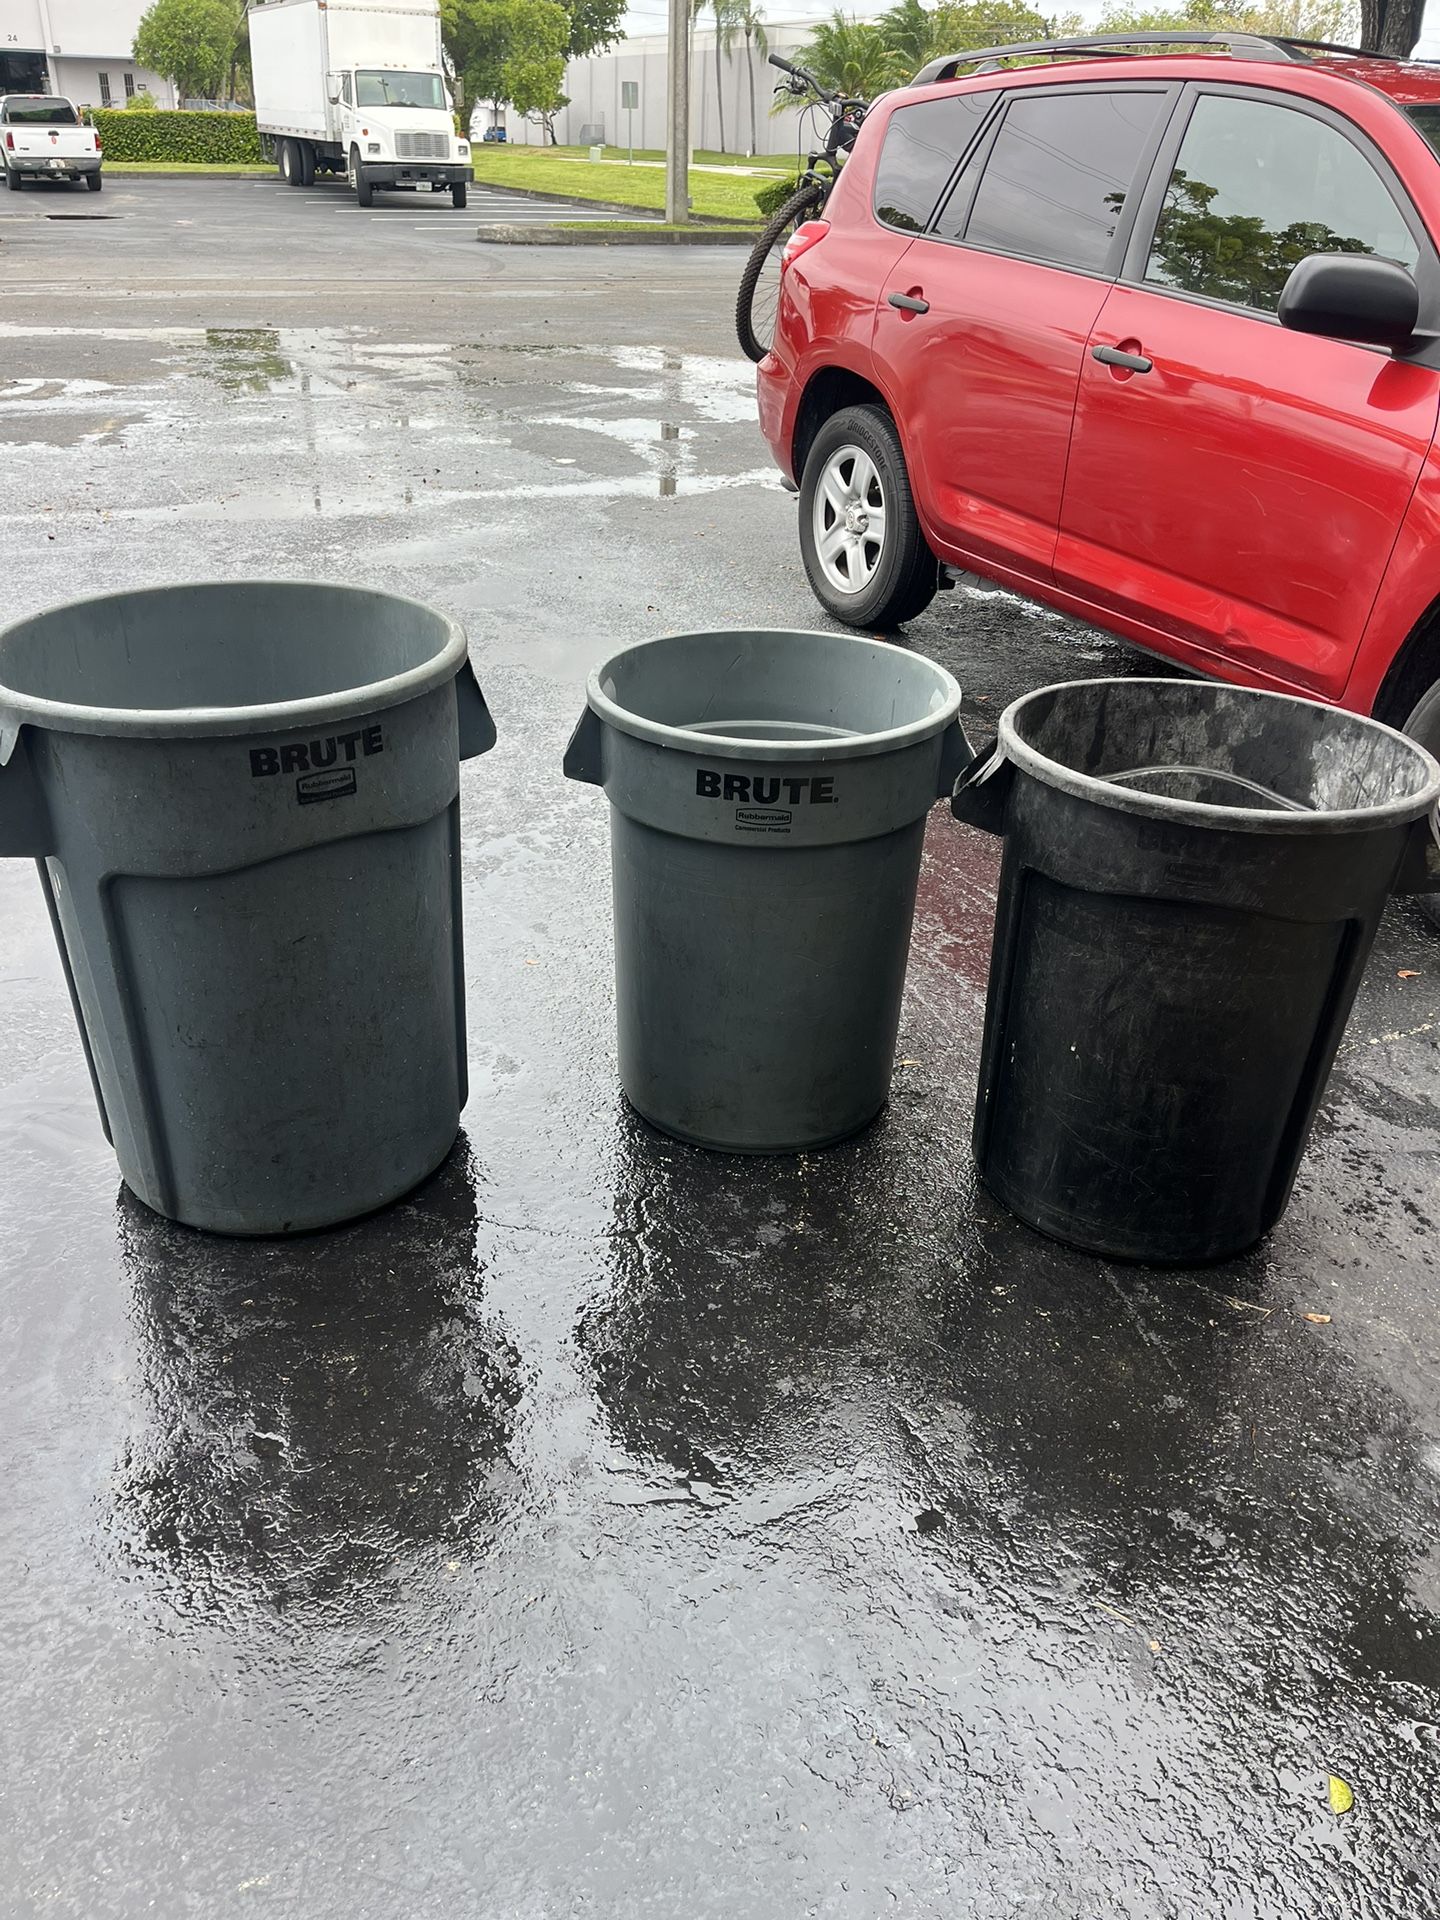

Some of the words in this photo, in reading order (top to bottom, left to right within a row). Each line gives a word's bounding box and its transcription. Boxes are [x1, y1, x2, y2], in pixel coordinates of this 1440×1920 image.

[7, 34, 18, 42] 24
[847, 419, 888, 472] BRIDGESTONE
[250, 725, 384, 777] BRUTE
[738, 812, 790, 821] Rubbermaid
[735, 824, 767, 832] Commercial
